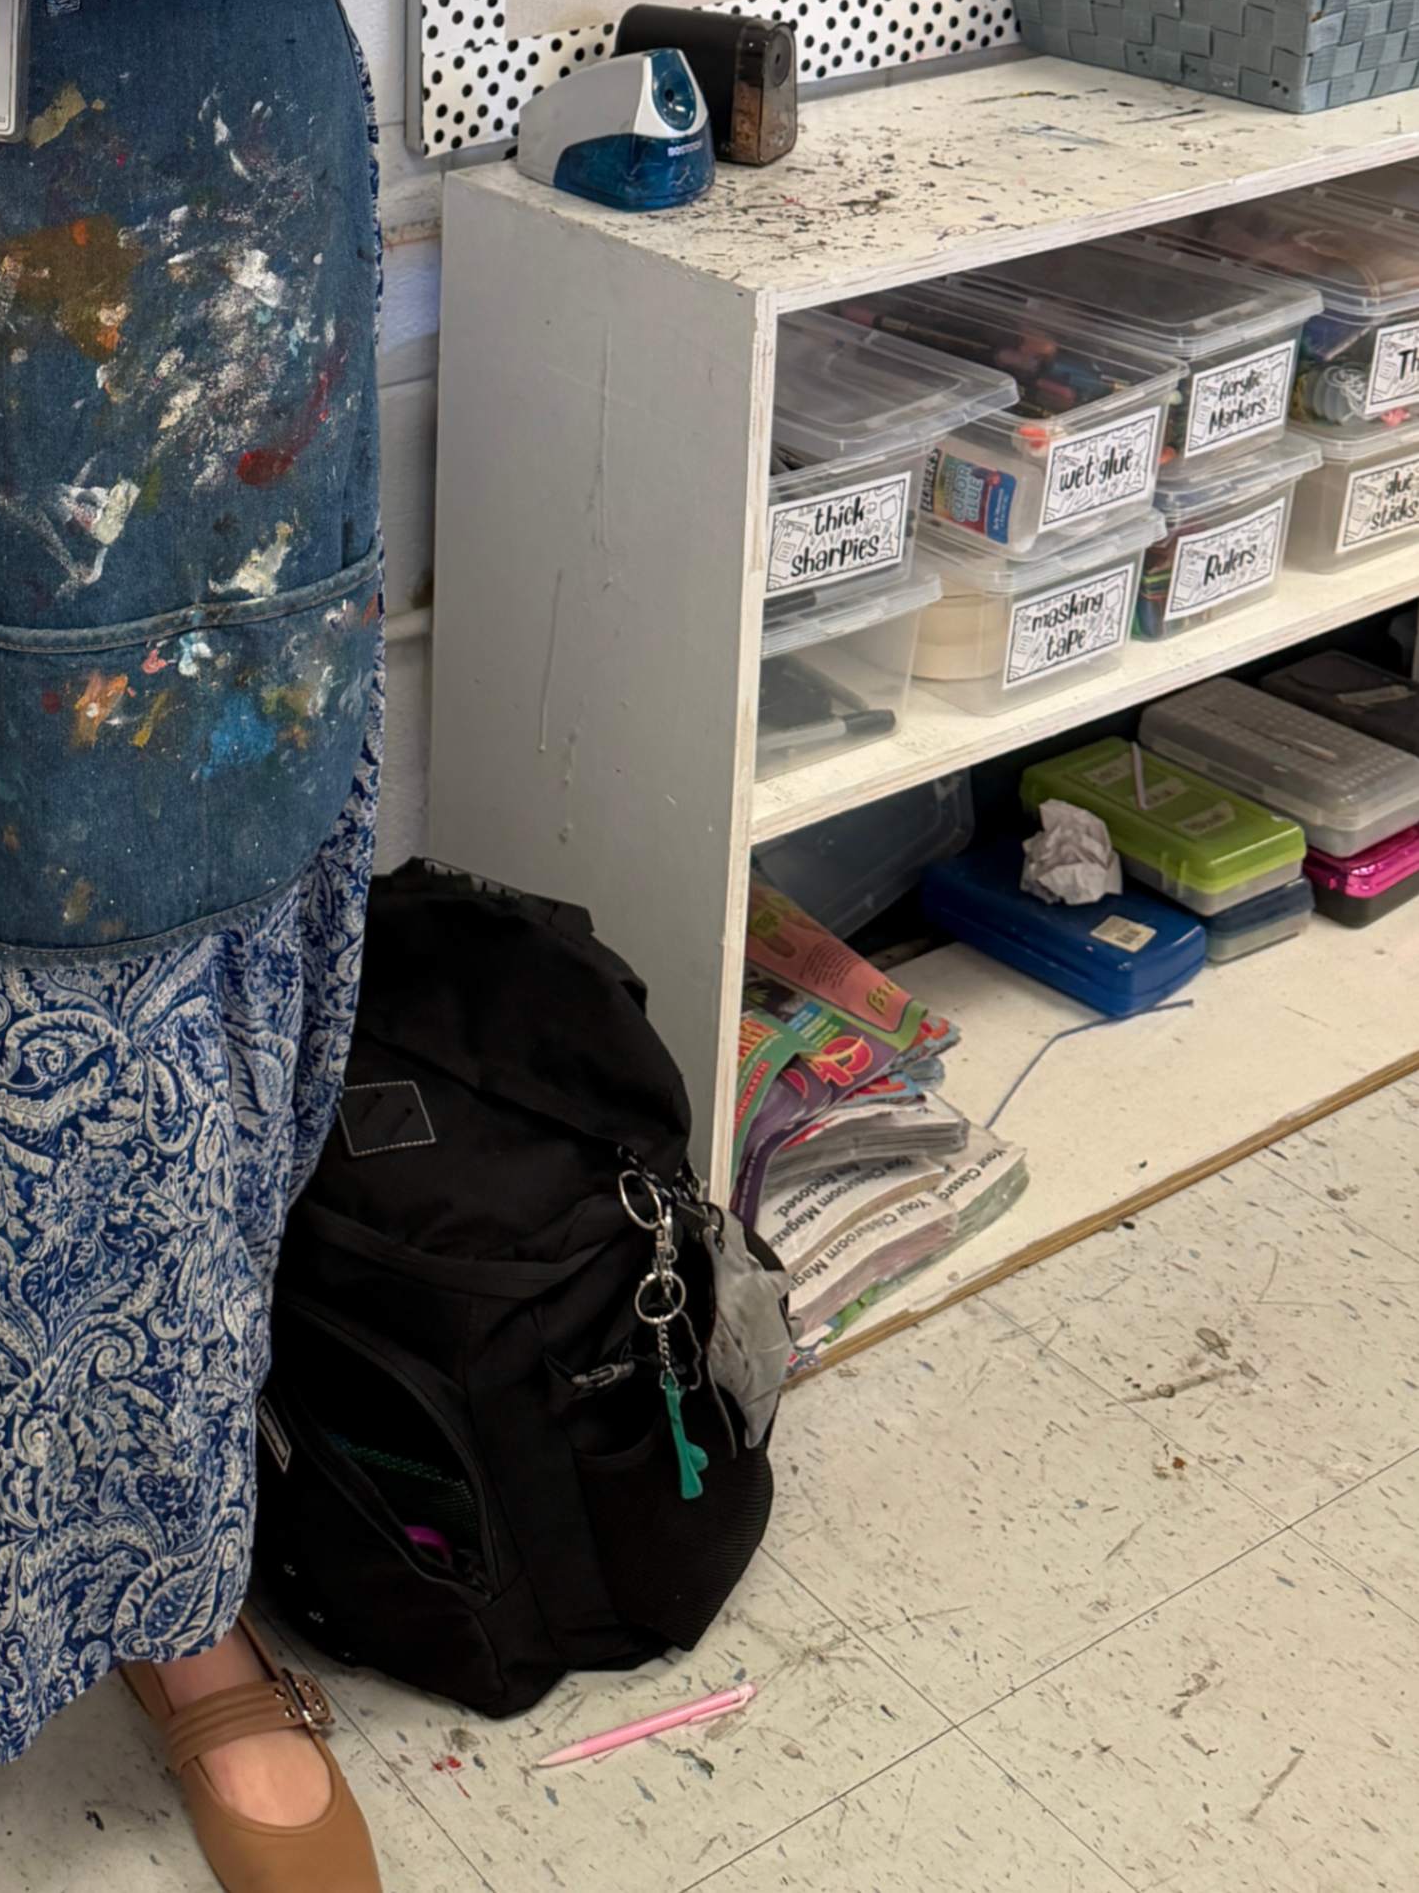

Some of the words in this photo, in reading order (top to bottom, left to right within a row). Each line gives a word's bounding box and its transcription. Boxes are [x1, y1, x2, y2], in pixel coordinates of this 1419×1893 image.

[1208, 397, 1267, 435] Markers
[1059, 455, 1095, 492] wet
[1098, 446, 1134, 484] glue
[1385, 471, 1414, 500] glue
[814, 495, 864, 536] thick
[1369, 497, 1419, 531] sticks
[1203, 543, 1258, 586] Rulers
[1031, 592, 1104, 633] masking
[978, 1147, 1007, 1170] Your
[774, 1169, 840, 1220] Enclosed.
[817, 1167, 887, 1209] Classroom
[895, 1198, 932, 1220] Your
[826, 1212, 899, 1262] Classroom
